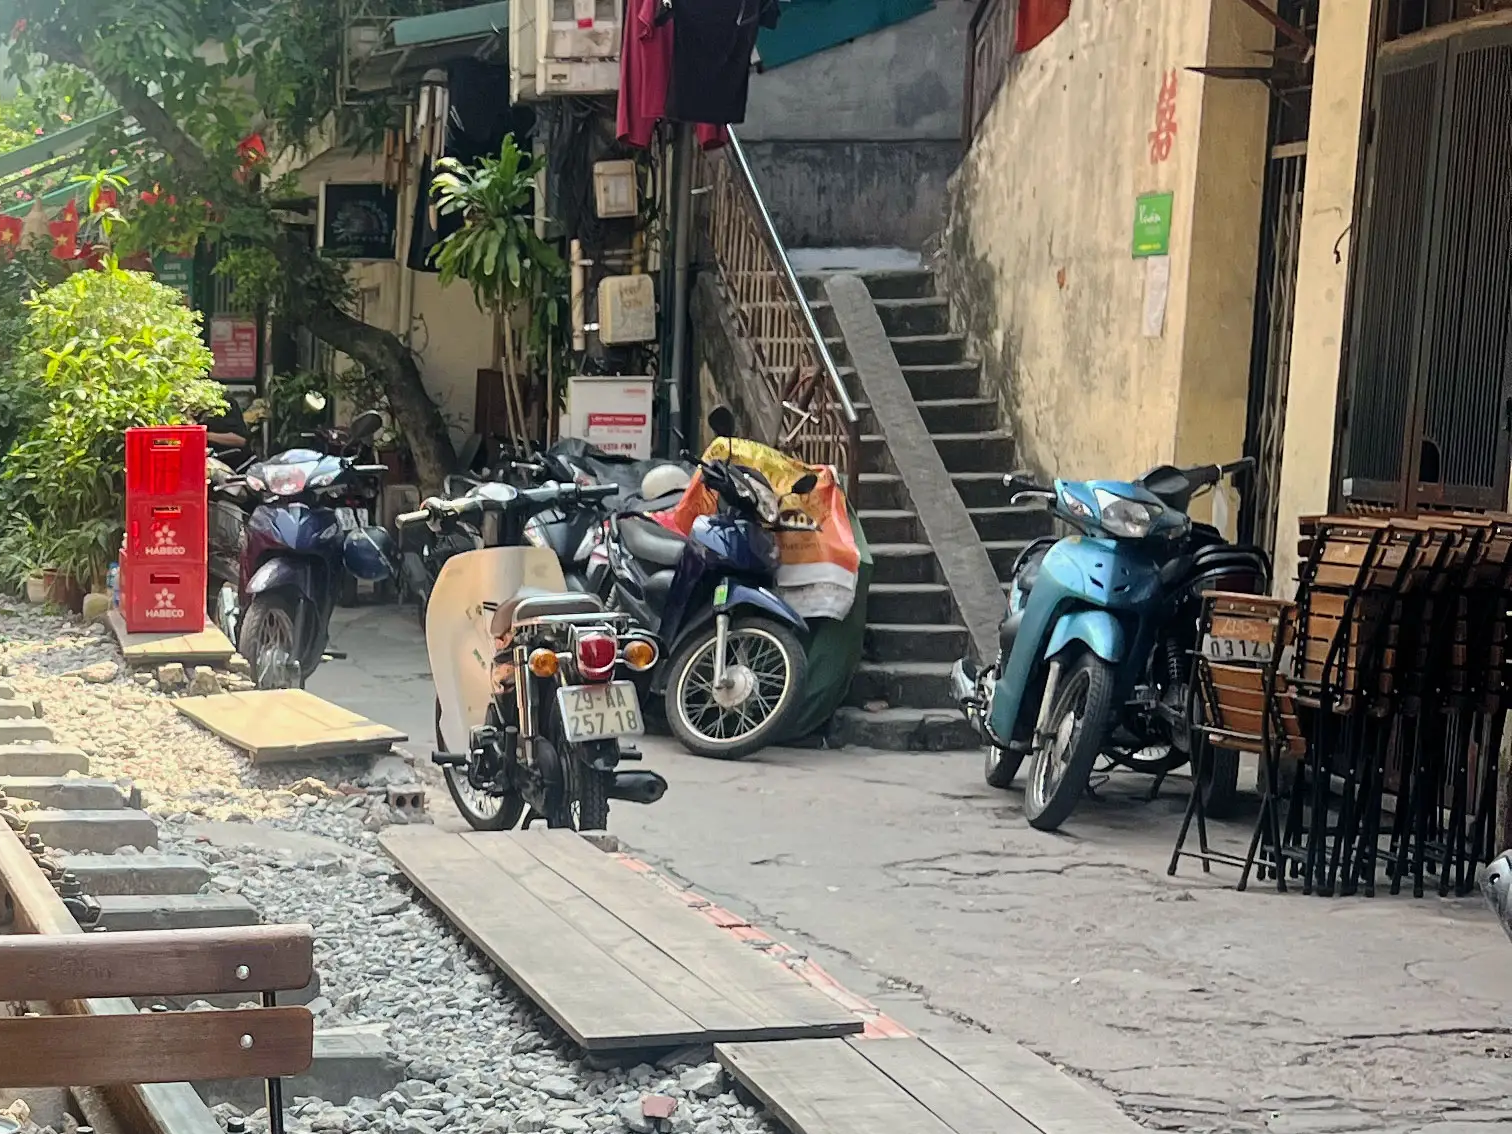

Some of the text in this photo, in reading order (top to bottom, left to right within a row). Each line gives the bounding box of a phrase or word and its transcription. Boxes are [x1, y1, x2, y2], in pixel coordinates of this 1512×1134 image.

[144, 546, 186, 555] HABECO
[145, 609, 185, 618] HABECO
[571, 686, 627, 712] 29-AA
[570, 709, 638, 737] 257.18
